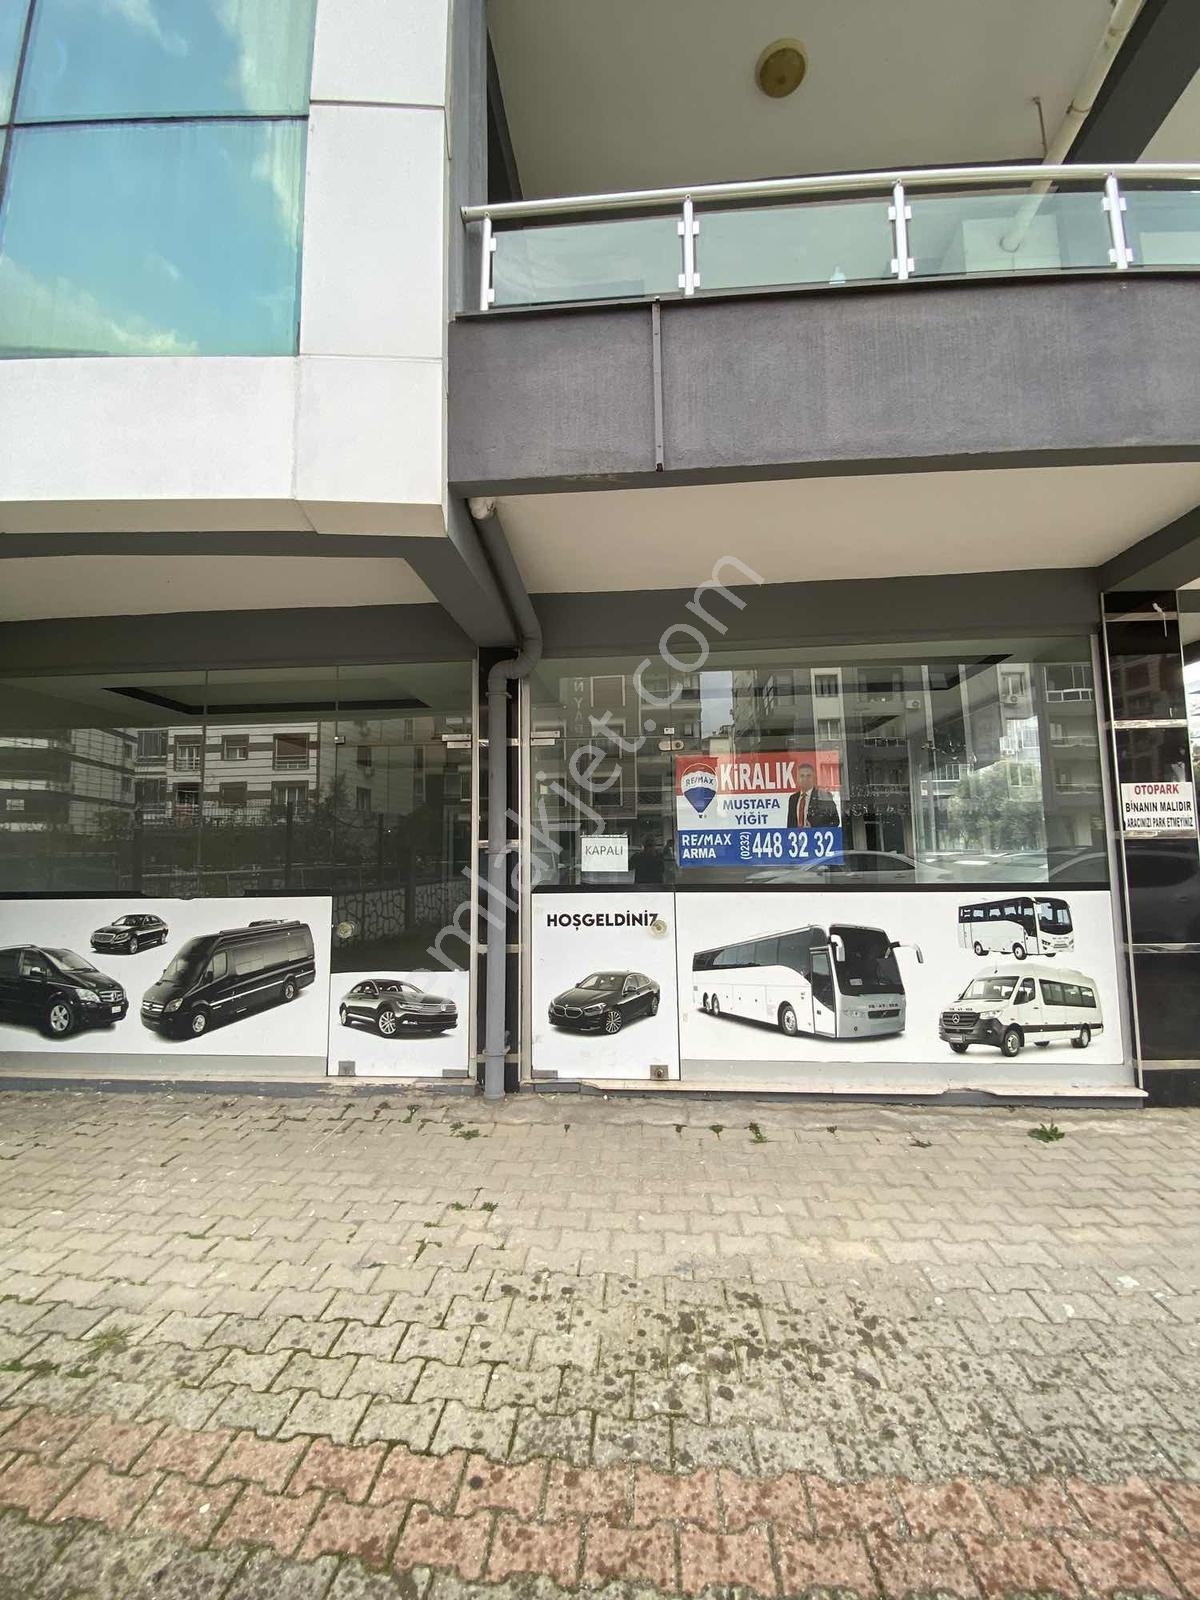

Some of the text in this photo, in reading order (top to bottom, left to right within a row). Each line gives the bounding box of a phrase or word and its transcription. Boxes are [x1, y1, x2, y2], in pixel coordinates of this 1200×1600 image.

[685, 774, 715, 788] RE/MAX
[1134, 784, 1179, 795] OTOPARK
[722, 798, 781, 810] MUSTAFA
[1160, 801, 1192, 812] MALIDIR
[735, 811, 769, 825] YİĞİT
[1153, 817, 1166, 828] PARK
[682, 833, 732, 846] RE/MAX
[585, 845, 623, 856] KAPALI
[739, 831, 835, 860] (0232) 448 32 32
[682, 848, 717, 859] ARMA
